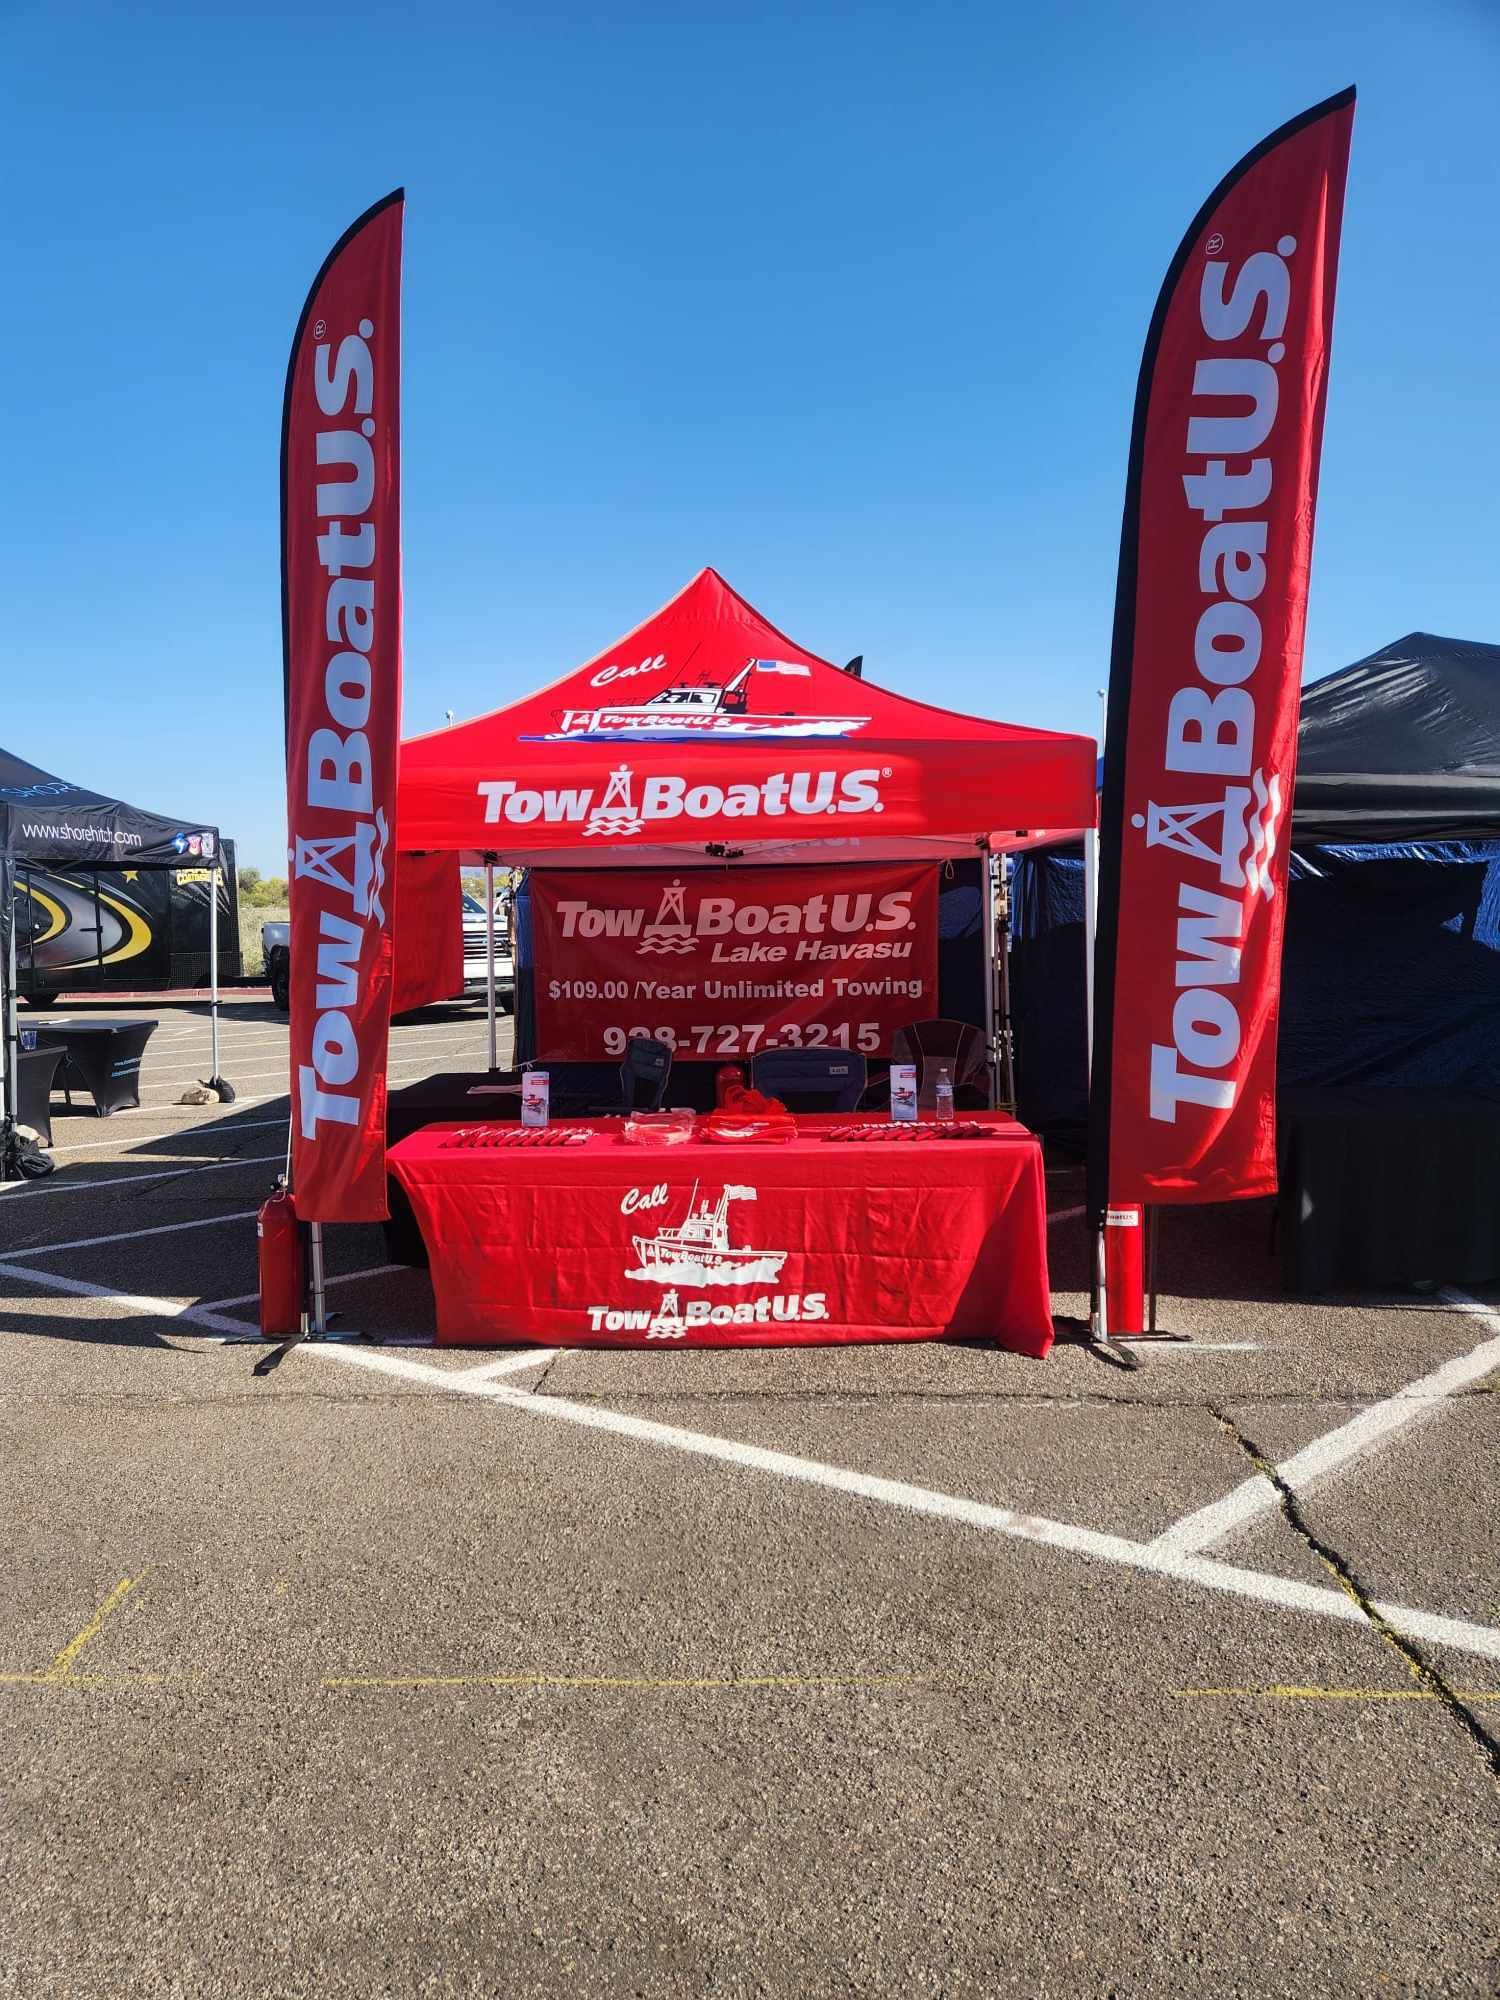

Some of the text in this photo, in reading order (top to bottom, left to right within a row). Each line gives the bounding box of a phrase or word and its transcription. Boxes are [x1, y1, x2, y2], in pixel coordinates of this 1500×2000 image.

[590, 654, 667, 687] Call
[477, 781, 593, 824] Tow
[22, 823, 143, 847] www.shorehitch.com
[556, 892, 917, 938] Tow BoatU.S.
[711, 940, 912, 963] Lake Havasu
[548, 977, 923, 1001] $109.00 /Year Unlimited Towing
[1150, 882, 1244, 1123] Tow
[299, 910, 365, 1142] Tow
[620, 1183, 669, 1215] Call
[587, 1293, 830, 1331] Tow BoatU.S.
